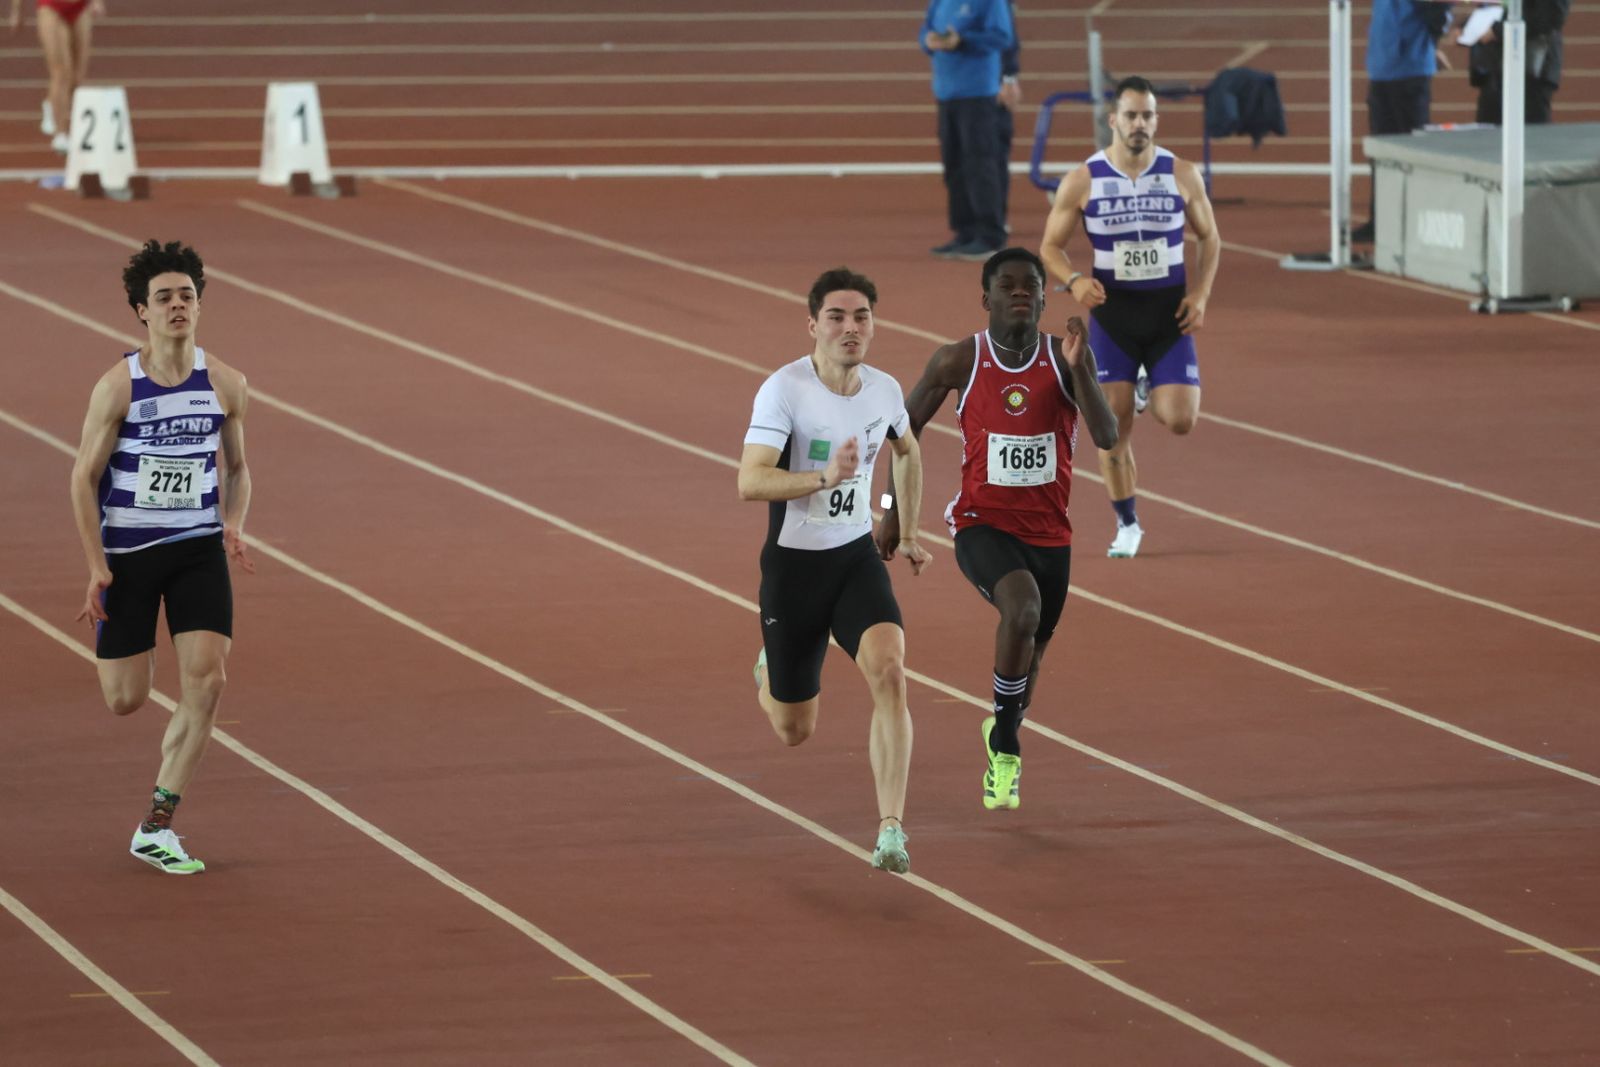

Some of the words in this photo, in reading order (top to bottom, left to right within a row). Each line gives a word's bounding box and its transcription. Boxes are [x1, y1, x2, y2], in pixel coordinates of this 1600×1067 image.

[80, 108, 97, 152] 2
[110, 108, 126, 152] 2
[293, 102, 309, 146] 1
[1097, 196, 1175, 215] RACING
[1124, 249, 1158, 266] 2610
[138, 417, 213, 438] RACING
[999, 446, 1047, 470] 1685
[149, 470, 192, 493] 2721
[828, 488, 855, 517] 94
